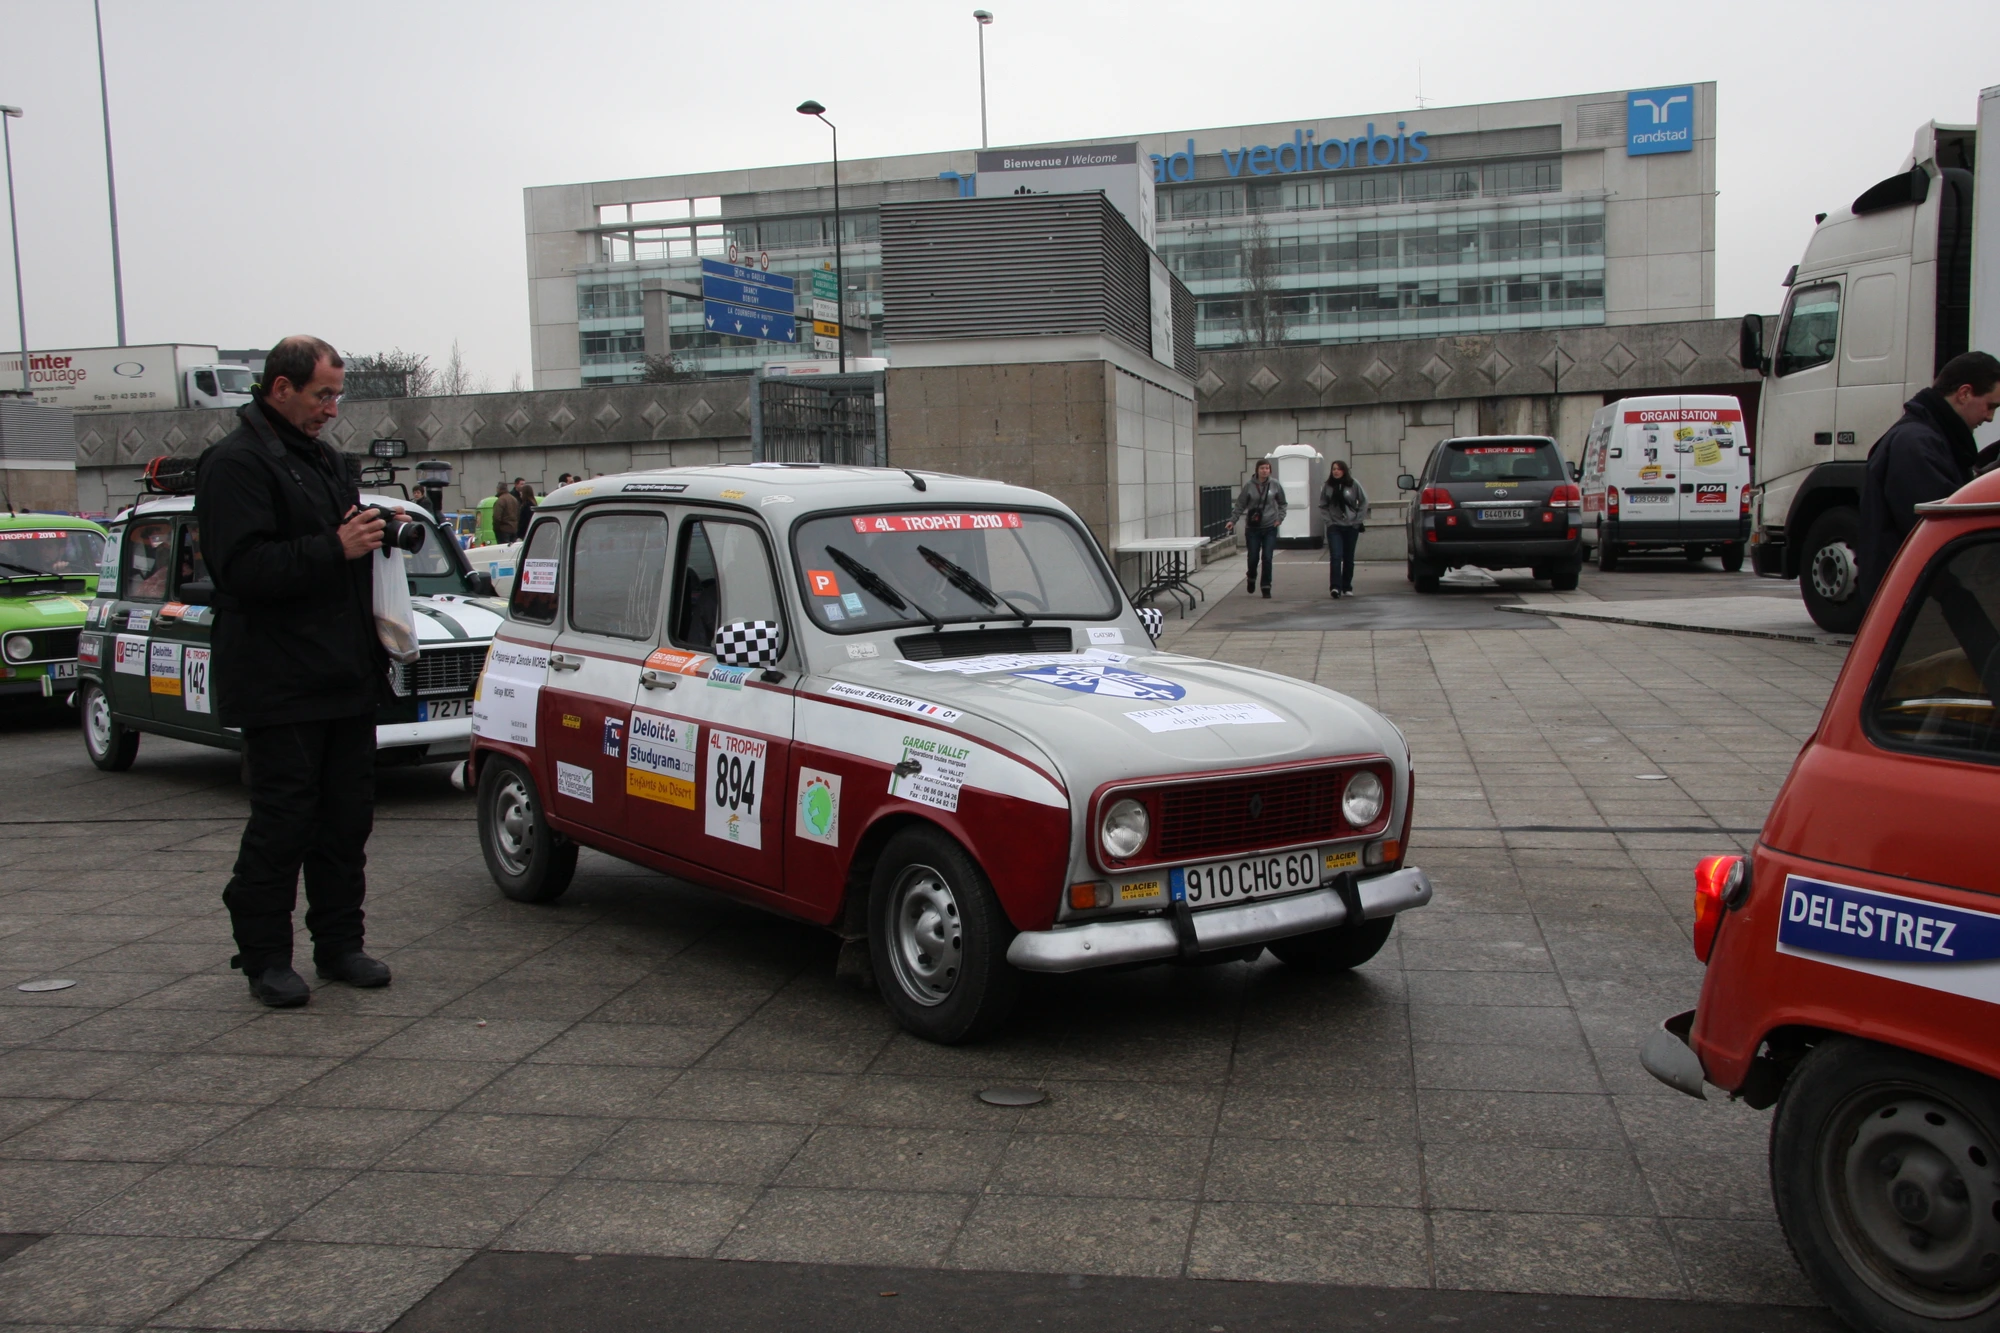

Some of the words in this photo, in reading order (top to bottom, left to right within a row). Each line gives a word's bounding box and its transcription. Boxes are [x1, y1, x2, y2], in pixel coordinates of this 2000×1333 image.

[1633, 127, 1687, 144] randstad
[1221, 121, 1429, 178] vediorbis
[1003, 157, 1062, 169] Bienvenue
[1064, 156, 1069, 166] /
[1072, 153, 1118, 165] Welcome
[29, 354, 73, 370] inter
[29, 367, 87, 385] routage
[1698, 484, 1724, 492] ADA
[874, 517, 896, 532] 4L
[901, 516, 961, 530] TROPHY
[969, 514, 1003, 528] 2010
[0, 532, 34, 540] TROPHY
[39, 531, 57, 539] 2010
[815, 575, 830, 591] P
[124, 641, 146, 659] EPF
[187, 661, 206, 695] 142
[709, 668, 729, 682] Sidi
[729, 672, 744, 685] ali
[831, 683, 866, 697] Jacques
[865, 689, 916, 708] BERGERON
[430, 701, 462, 718] 727
[1172, 713, 1218, 726] depuis
[710, 733, 722, 749] 4L
[726, 736, 766, 759] TROPHY
[902, 735, 937, 753] GARAGE
[937, 743, 970, 760] VALLET
[947, 758, 967, 769] marques
[630, 772, 657, 791] Enfants
[948, 769, 965, 778] VALLET
[715, 752, 756, 816] 894
[909, 790, 918, 799] Fax
[729, 822, 740, 834] ESC
[1325, 851, 1357, 863] ID.ACIER
[1121, 881, 1158, 893] ID.ACIER
[1788, 890, 1958, 957] DELESTREZ
